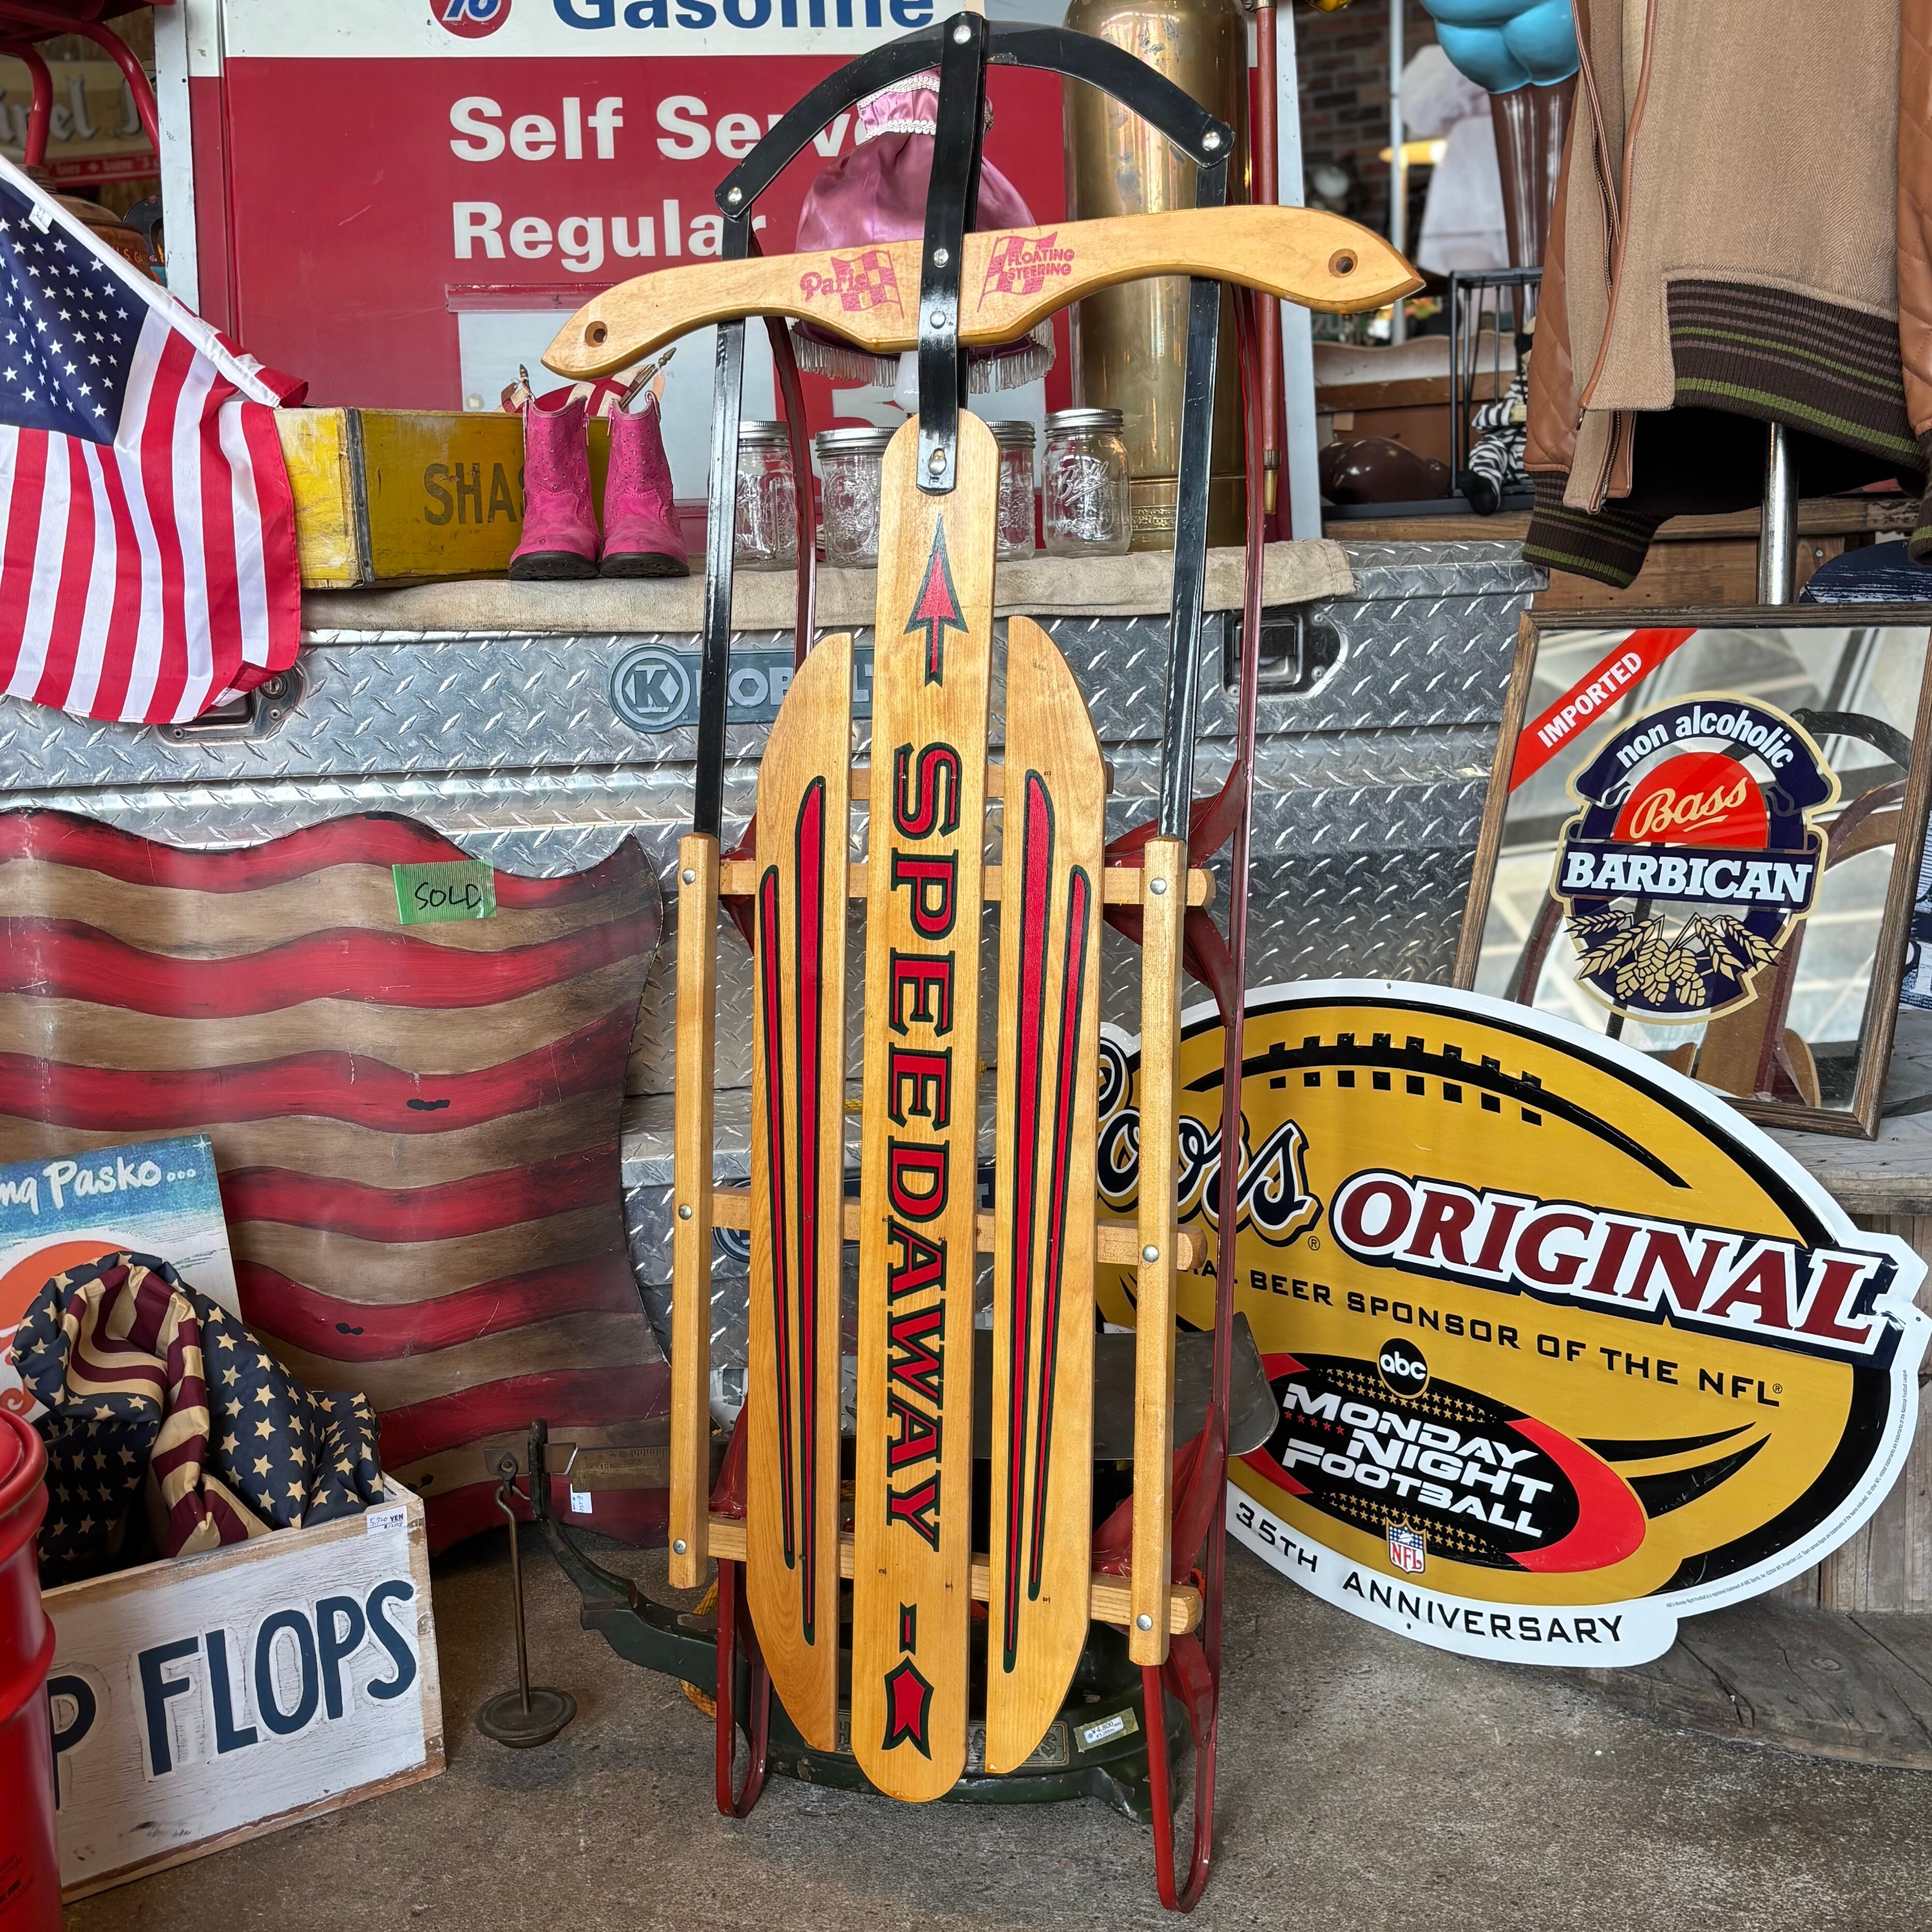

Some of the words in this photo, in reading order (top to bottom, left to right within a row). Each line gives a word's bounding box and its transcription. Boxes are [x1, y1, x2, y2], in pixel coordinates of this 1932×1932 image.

[450, 96, 624, 162] Self
[656, 95, 868, 160] Sev
[799, 268, 869, 303] Paris
[1007, 248, 1075, 266] FLOATING
[1007, 263, 1071, 281] STEERING
[424, 462, 524, 526] SHA
[1536, 651, 1643, 749] IMPORTED
[1616, 722, 1670, 769] non
[1675, 704, 1795, 770] alcoholic
[1629, 776, 1748, 839] Bass
[414, 881, 482, 910] SOLD
[1562, 850, 1813, 905] BARBICAN
[886, 741, 963, 1552] SPEEDAWAY
[1337, 1176, 1891, 1350] ORIGINAL
[1251, 1269, 1334, 1306] BEER
[1348, 1293, 1522, 1349] SPONSOR
[1536, 1334, 1588, 1362] OF
[1600, 1347, 1679, 1386] THE
[1379, 1350, 1427, 1380] abc
[1282, 1383, 1539, 1470] MONDAY
[1282, 1437, 1543, 1539] FOOTBALL
[1346, 1427, 1554, 1505] NIGHT
[390, 1513, 404, 1522] YEN
[1235, 1501, 1318, 1573] 35TH
[1343, 1571, 1623, 1644] ANNIVERSARY
[1390, 1542, 1422, 1571] NFL
[138, 1578, 417, 1777] FLOPS
